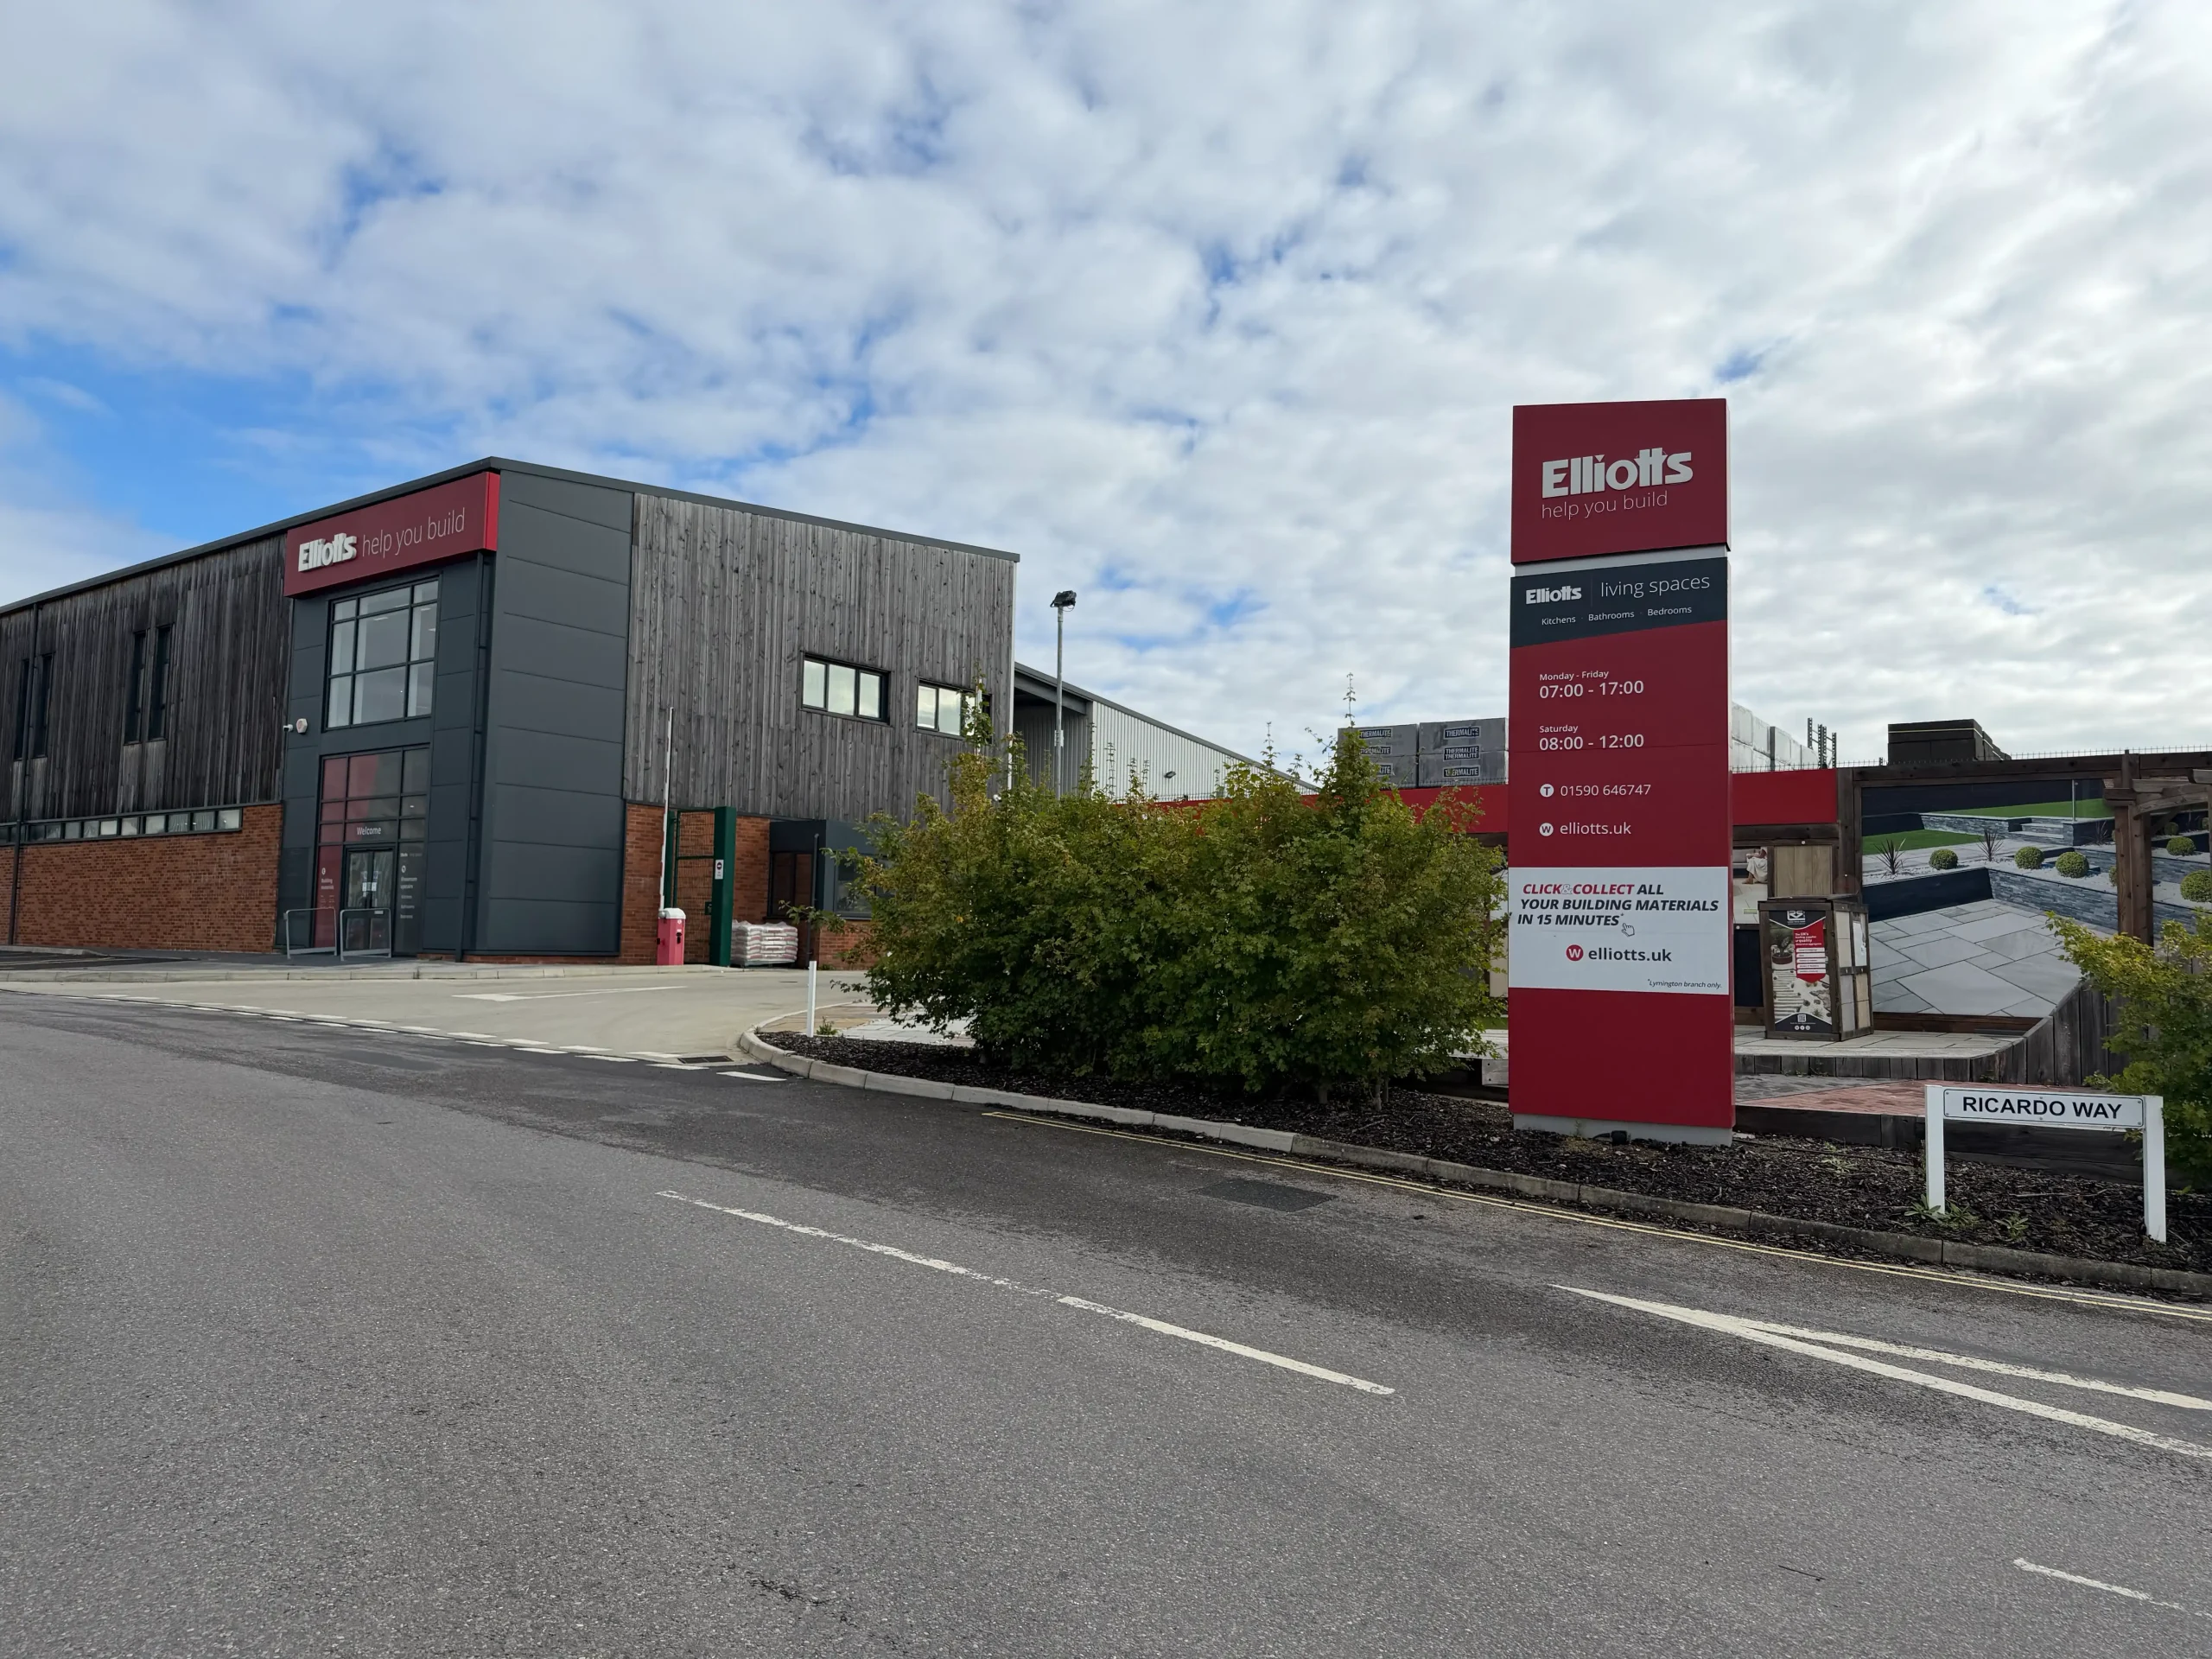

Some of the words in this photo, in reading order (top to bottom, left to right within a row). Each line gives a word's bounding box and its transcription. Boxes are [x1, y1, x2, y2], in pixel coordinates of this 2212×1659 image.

[1542, 448, 1694, 499] Elliotts
[1541, 502, 1579, 520] help
[1584, 499, 1617, 518] you
[1624, 490, 1668, 509] build
[298, 532, 357, 572] Elliotts
[362, 530, 392, 558] help
[395, 525, 422, 556] you
[428, 507, 466, 540] build
[1525, 585, 1582, 605] Elliotts
[1601, 581, 1643, 598] living
[1649, 576, 1710, 594] spaces
[1541, 615, 1576, 626] Kitchens
[1588, 610, 1635, 621] Bathrooms
[1647, 606, 1692, 616] Bedrooms
[1539, 672, 1574, 681] Monday
[1581, 670, 1609, 679] Friday
[1539, 683, 1583, 698] 07:00
[1599, 680, 1644, 696] 17:00
[1539, 725, 1579, 734] Saturday
[1539, 736, 1583, 751] 08:00
[1599, 734, 1644, 748] 12:00
[1560, 785, 1599, 797] 01590
[1603, 784, 1651, 796] 646747
[357, 826, 381, 836] Welcome
[1560, 823, 1631, 835] elliotts.uk
[1637, 884, 1664, 895] ALL
[1521, 899, 1559, 910] YOUR
[1562, 899, 1631, 911] BUILDING
[1636, 899, 1719, 912] MATERIALS
[1517, 914, 1533, 925] IN
[1536, 914, 1552, 925] 15
[1588, 948, 1672, 962] elliotts.uk
[1963, 1096, 2065, 1116] RICARDO
[2072, 1102, 2122, 1119] WAY
